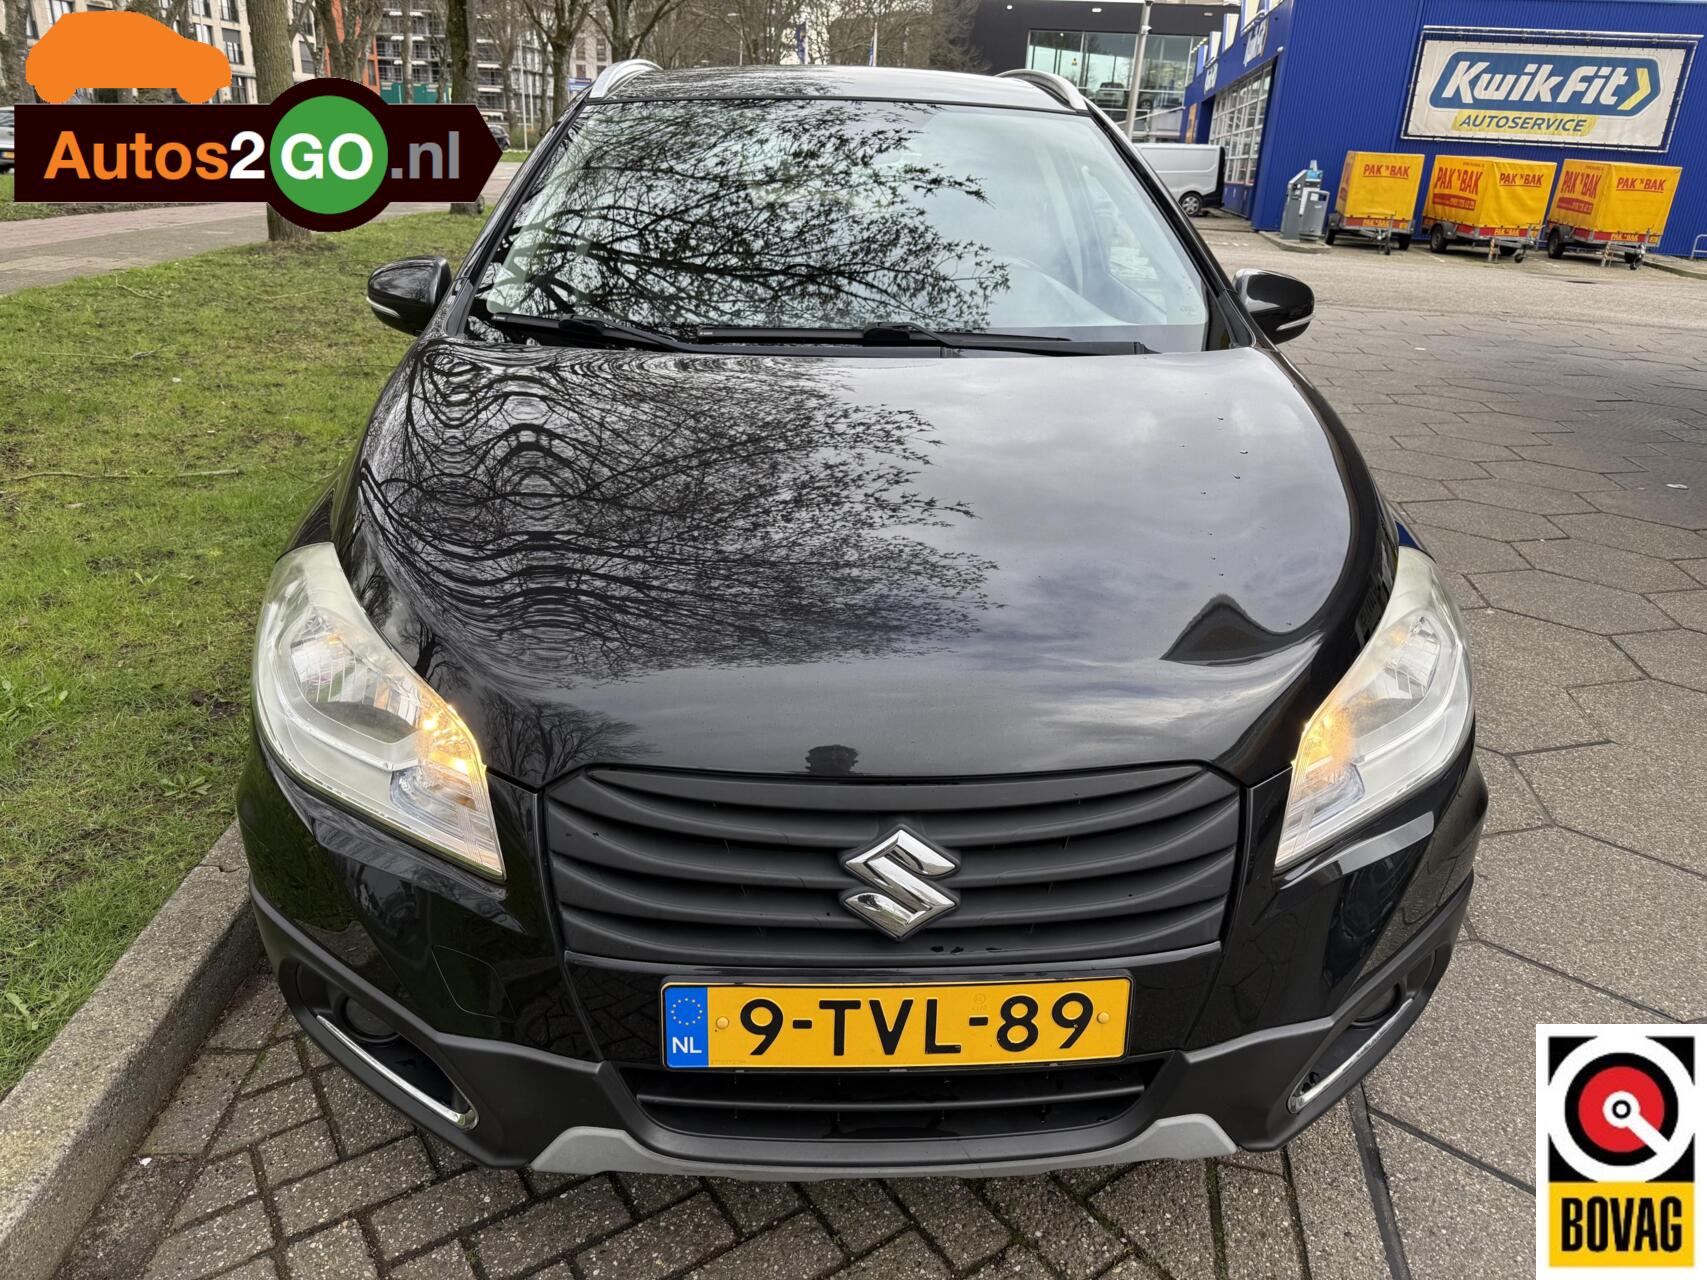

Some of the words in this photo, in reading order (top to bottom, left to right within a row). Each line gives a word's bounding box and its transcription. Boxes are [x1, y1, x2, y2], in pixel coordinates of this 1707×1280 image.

[1459, 114, 1588, 132] AUTOSERVICE
[1363, 164, 1383, 176] PAK
[1389, 165, 1410, 177] BAK
[1499, 172, 1518, 184] PAK
[1524, 174, 1544, 185] BAK
[1434, 166, 1456, 190] PAK
[1459, 169, 1483, 195] BAK
[1560, 170, 1581, 194] PAK
[1582, 173, 1602, 199] BAK
[1616, 177, 1638, 189] PAK
[1644, 179, 1666, 190] BAK
[740, 992, 1094, 1056] 9-TVL-89
[672, 1036, 702, 1053] NL
